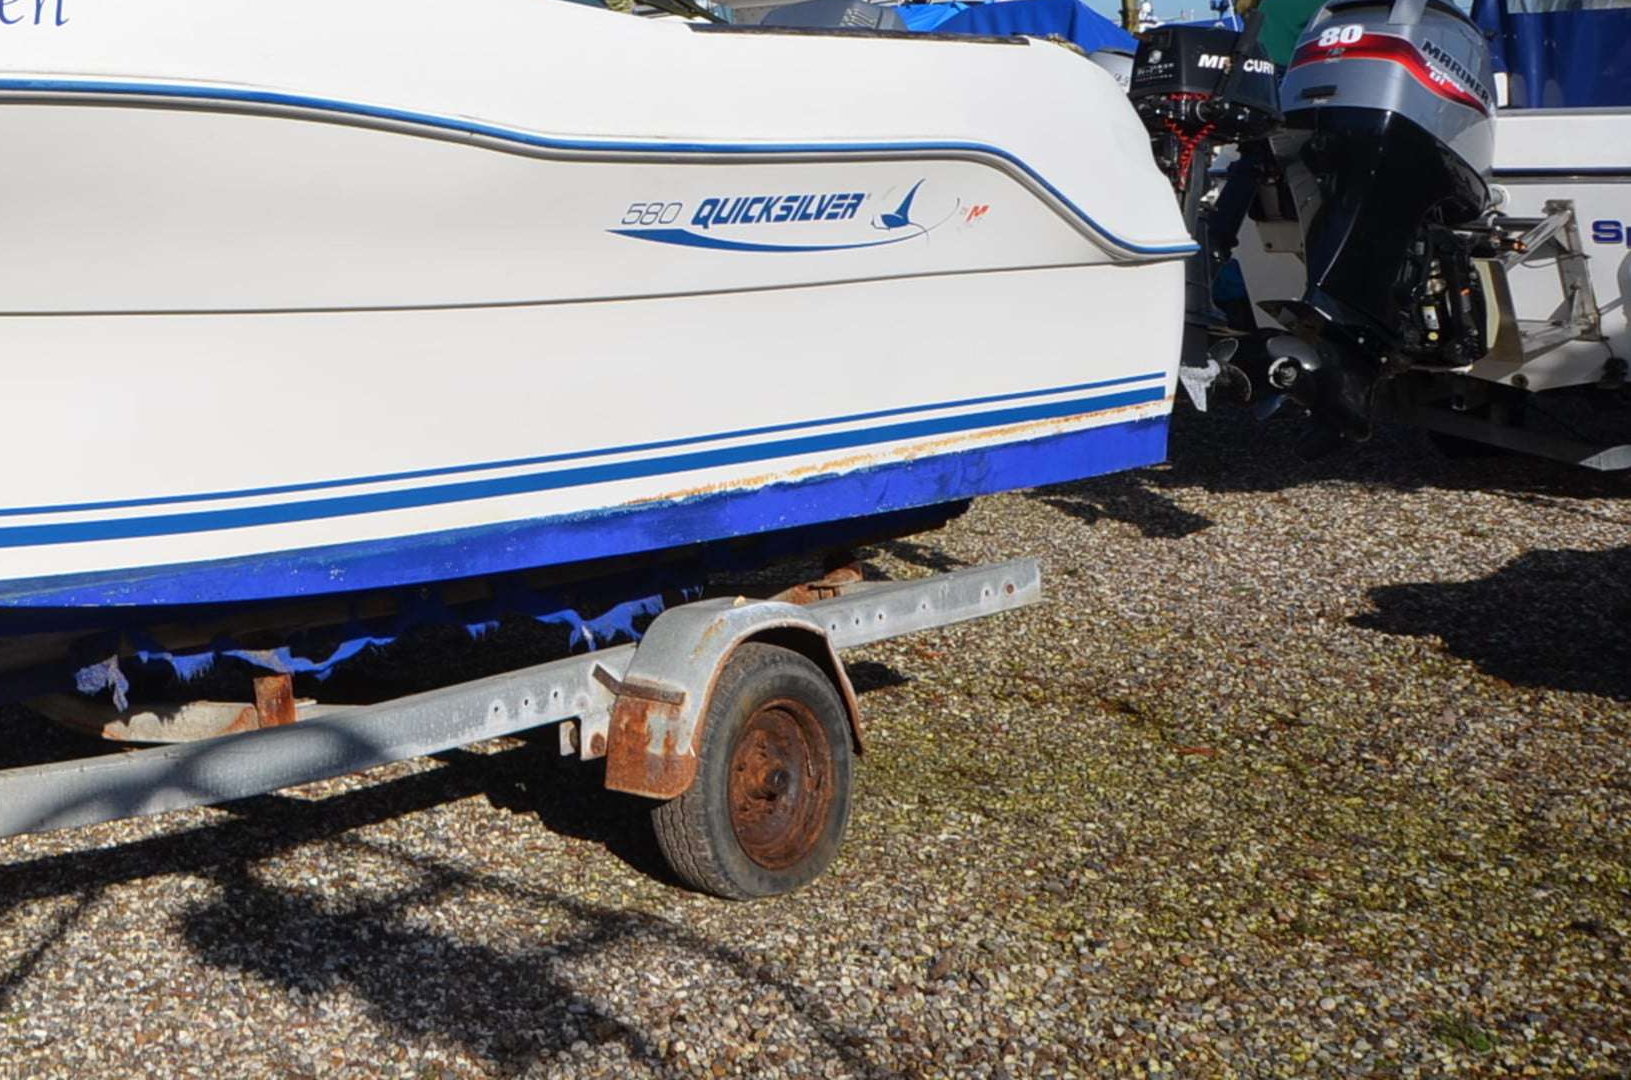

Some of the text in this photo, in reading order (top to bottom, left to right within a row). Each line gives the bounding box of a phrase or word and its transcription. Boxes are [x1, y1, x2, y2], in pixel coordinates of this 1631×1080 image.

[1318, 24, 1364, 47] 80
[1198, 53, 1274, 75] MCUR
[1422, 39, 1490, 105] MARINER
[621, 192, 868, 229] 580 QUICKSILVER
[1592, 220, 1631, 249] S
